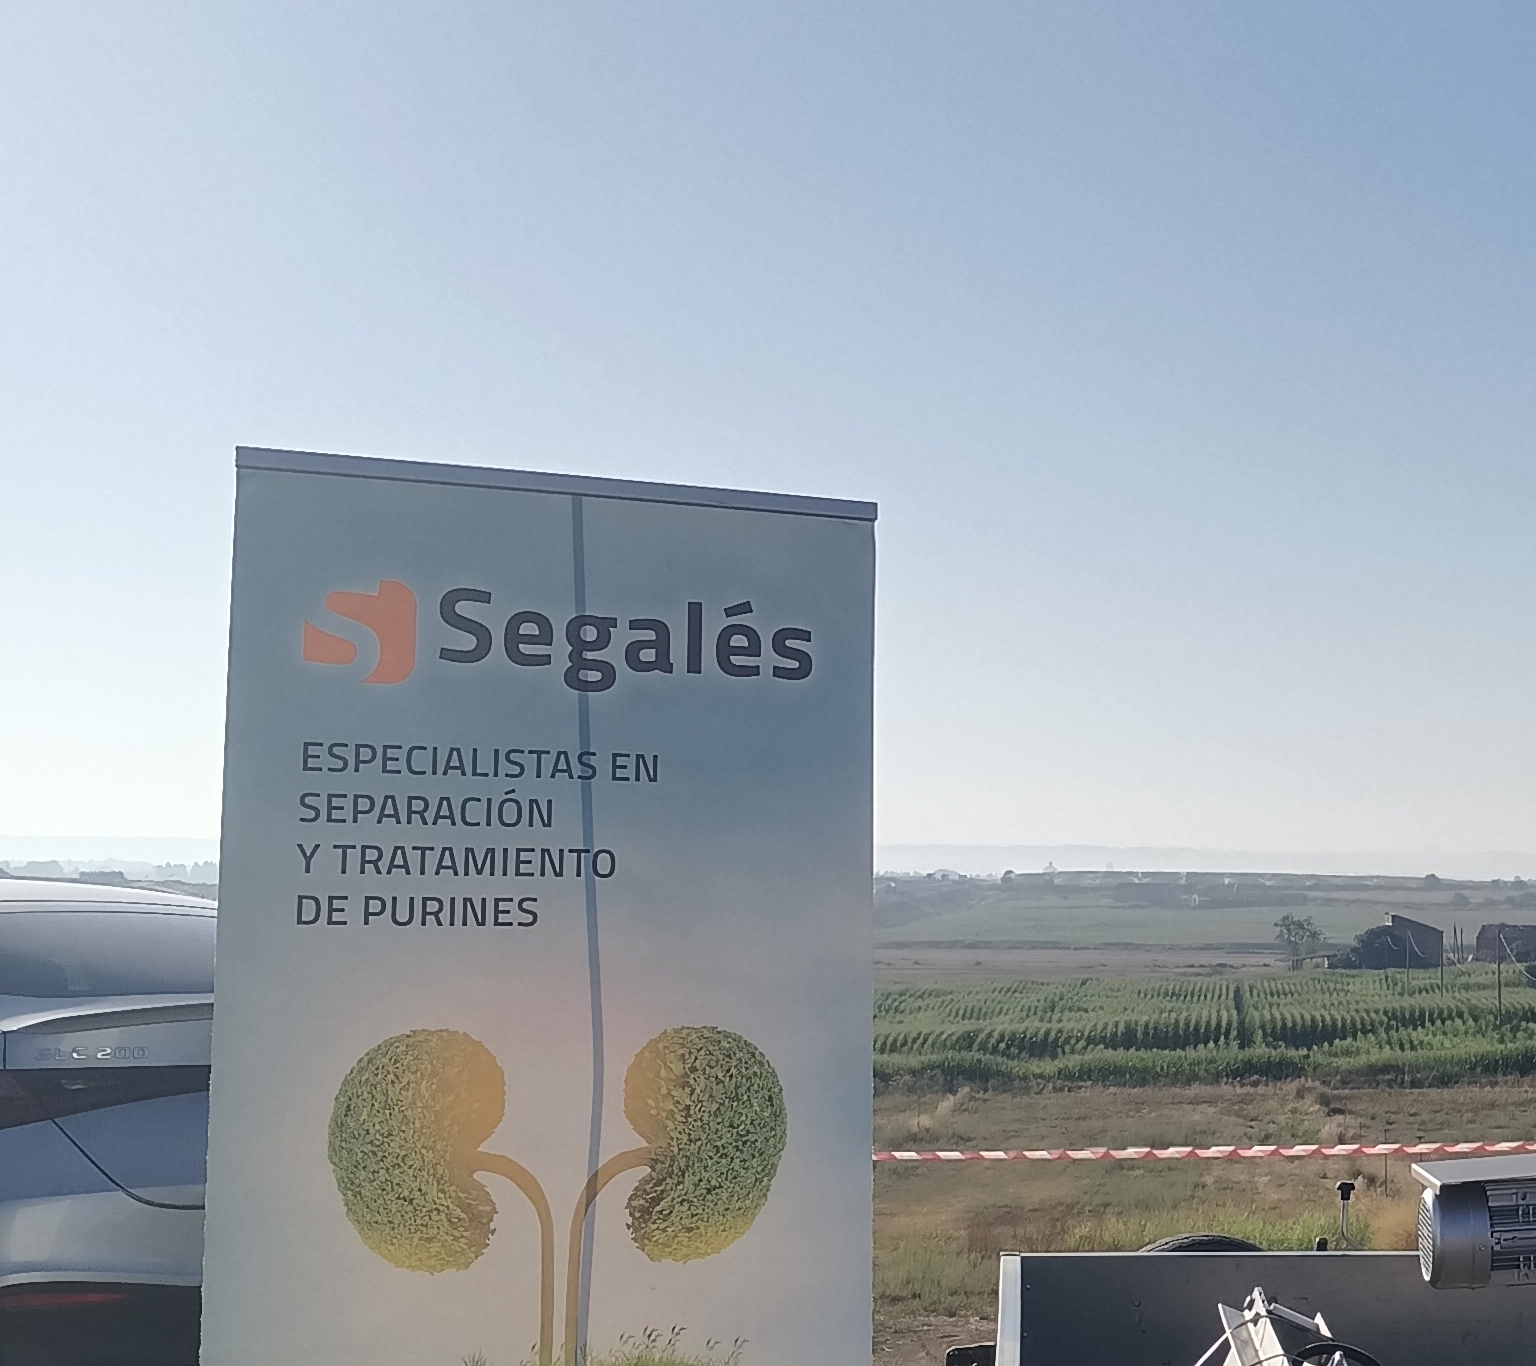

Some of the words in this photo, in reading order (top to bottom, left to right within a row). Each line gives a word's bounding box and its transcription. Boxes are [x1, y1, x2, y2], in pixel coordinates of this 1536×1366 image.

[438, 587, 814, 693] Segalés
[301, 740, 598, 781] ESPECIALISTAS
[611, 751, 659, 783] EN
[298, 788, 553, 828] SEPARACIÓN
[296, 843, 321, 874] Y
[333, 843, 617, 879] TRATAMIENTO
[296, 894, 349, 926] DE
[363, 895, 539, 927] PURINES
[96, 1046, 149, 1060] 200
